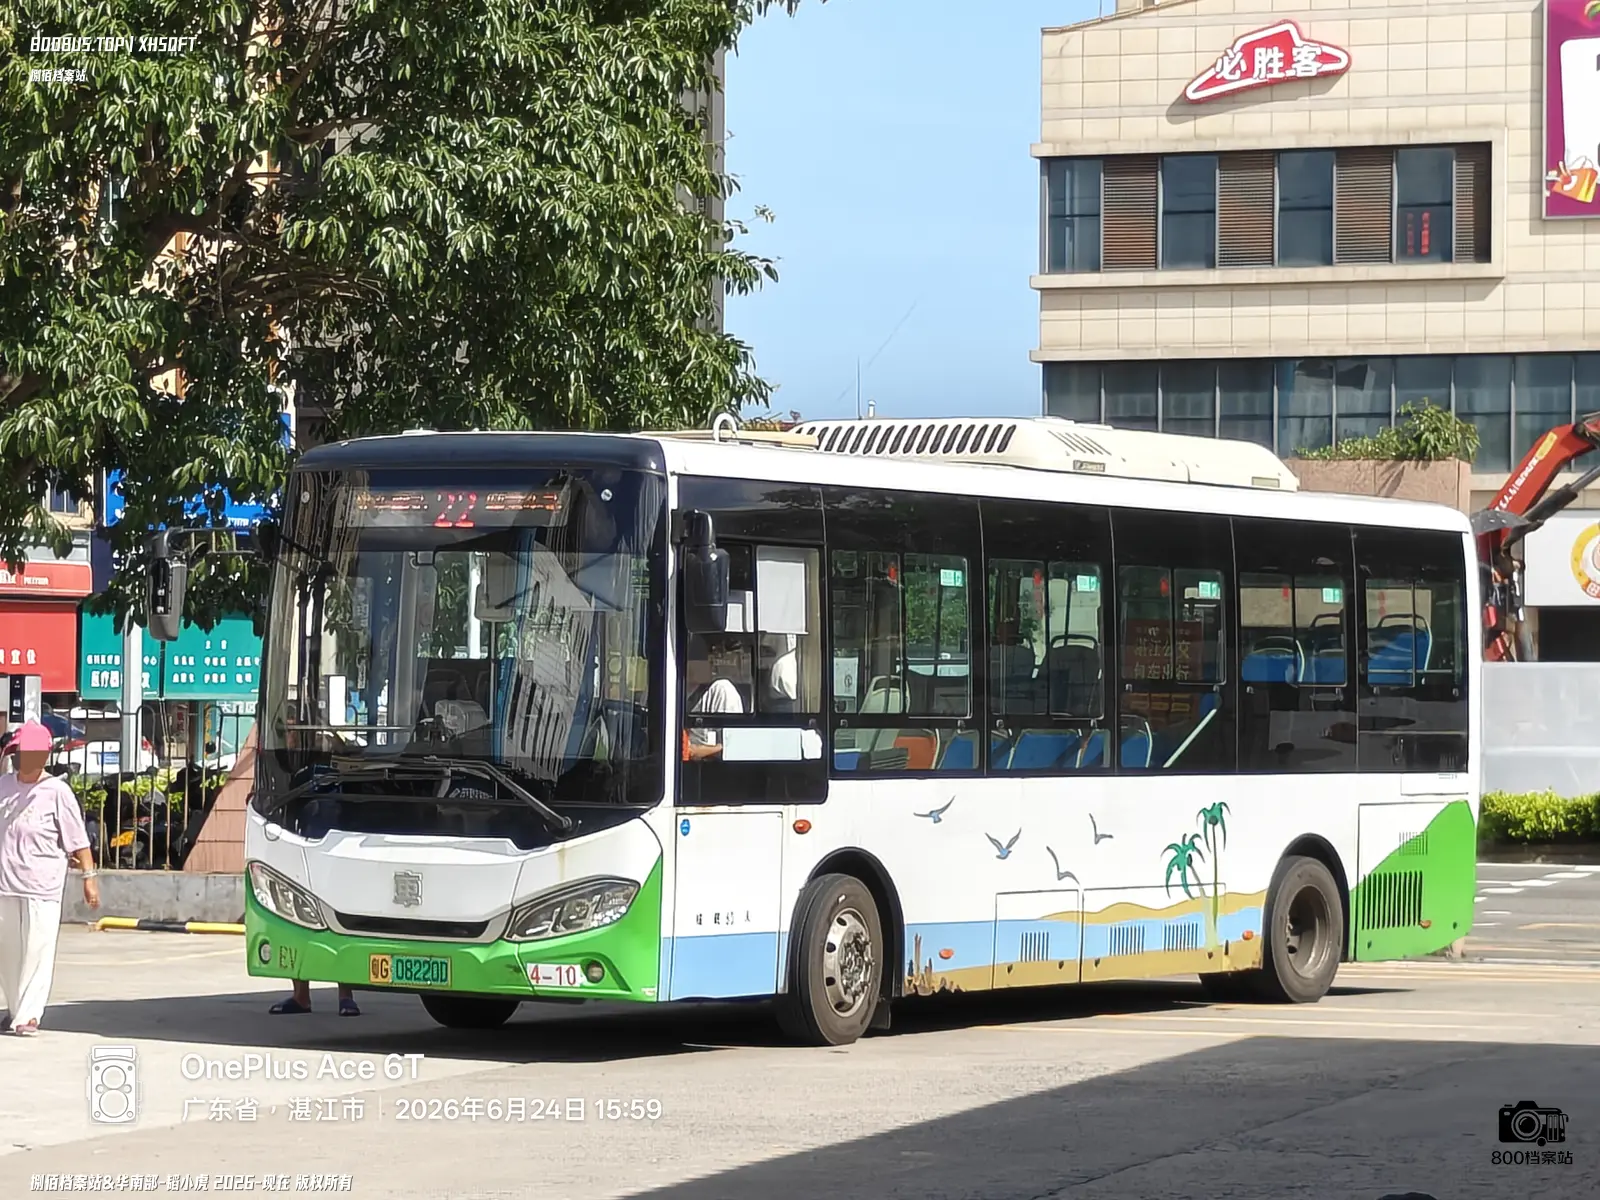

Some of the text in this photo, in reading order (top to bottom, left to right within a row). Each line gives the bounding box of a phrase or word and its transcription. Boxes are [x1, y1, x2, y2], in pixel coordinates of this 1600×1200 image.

[1215, 44, 1323, 80] 必胜客
[434, 491, 477, 528] 22
[279, 945, 298, 970] EV
[530, 964, 577, 986] 4-10
